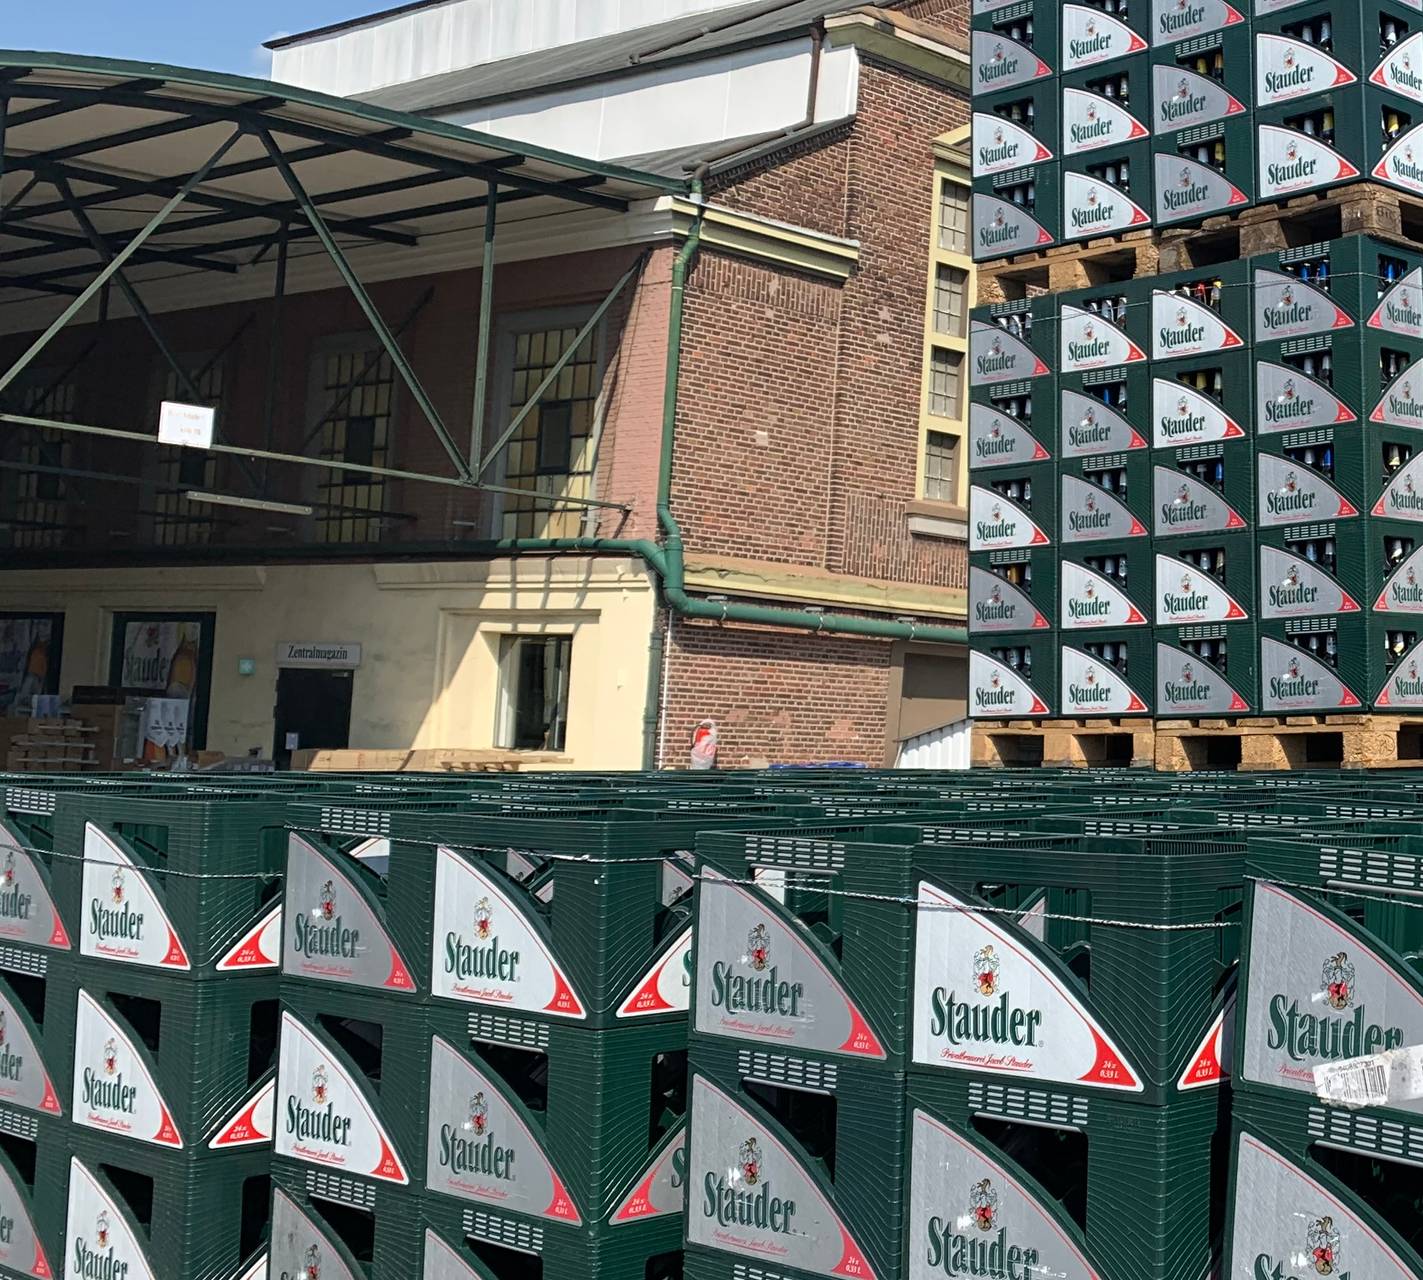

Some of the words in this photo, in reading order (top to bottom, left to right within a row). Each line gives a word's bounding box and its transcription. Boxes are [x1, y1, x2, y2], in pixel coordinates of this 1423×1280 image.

[1160, 8, 1204, 35] Stauder
[1070, 32, 1111, 59] Stauder
[979, 59, 1017, 84] Stauder
[1266, 64, 1313, 93] Stauder
[1390, 63, 1421, 90] Stauder
[1162, 95, 1205, 122] Stauder
[1071, 118, 1111, 143] Stauder
[980, 141, 1018, 166] Stauder
[1268, 157, 1315, 185] Stauder
[1392, 156, 1423, 181] Stauder
[1164, 184, 1208, 211] Stauder
[1072, 202, 1113, 228] Stauder
[980, 223, 1018, 248] Stauder
[1264, 303, 1311, 330] Stauder
[1388, 304, 1420, 326] Stauder
[1160, 323, 1204, 349] Stauder
[1068, 338, 1109, 362] Stauder
[977, 351, 1017, 376] Stauder
[1266, 396, 1313, 423] Stauder
[1391, 396, 1423, 418] Stauder
[1069, 424, 1110, 447] Stauder
[1161, 413, 1204, 437] Stauder
[976, 436, 1015, 458] Stauder
[1267, 490, 1315, 515] Stauder
[1392, 490, 1423, 510] Stauder
[1069, 510, 1110, 533] Stauder
[1162, 501, 1206, 526] Stauder
[976, 519, 1015, 541] Stauder
[1069, 596, 1110, 619] Stauder
[1164, 591, 1208, 614] Stauder
[1269, 583, 1317, 608] Stauder
[977, 602, 1015, 623] Stauder
[288, 644, 348, 661] Zentralmagazin
[976, 686, 1014, 708] Stauder
[1069, 684, 1110, 706] Stauder
[1165, 681, 1209, 705] Stauder
[1270, 676, 1318, 701] Stauder
[90, 898, 144, 940] Stauder
[294, 913, 359, 958] Stauder
[444, 931, 520, 983] Stauder
[712, 961, 804, 1017] Stauder
[931, 986, 1041, 1047] Stauder
[1267, 994, 1404, 1061] Stauder
[82, 1067, 136, 1114] Stauder
[286, 1095, 352, 1146] Stauder
[439, 1123, 516, 1181] Stauder
[704, 1171, 796, 1233] Stauder
[74, 1236, 128, 1280] Stauder
[927, 1216, 1039, 1280] Stauder
